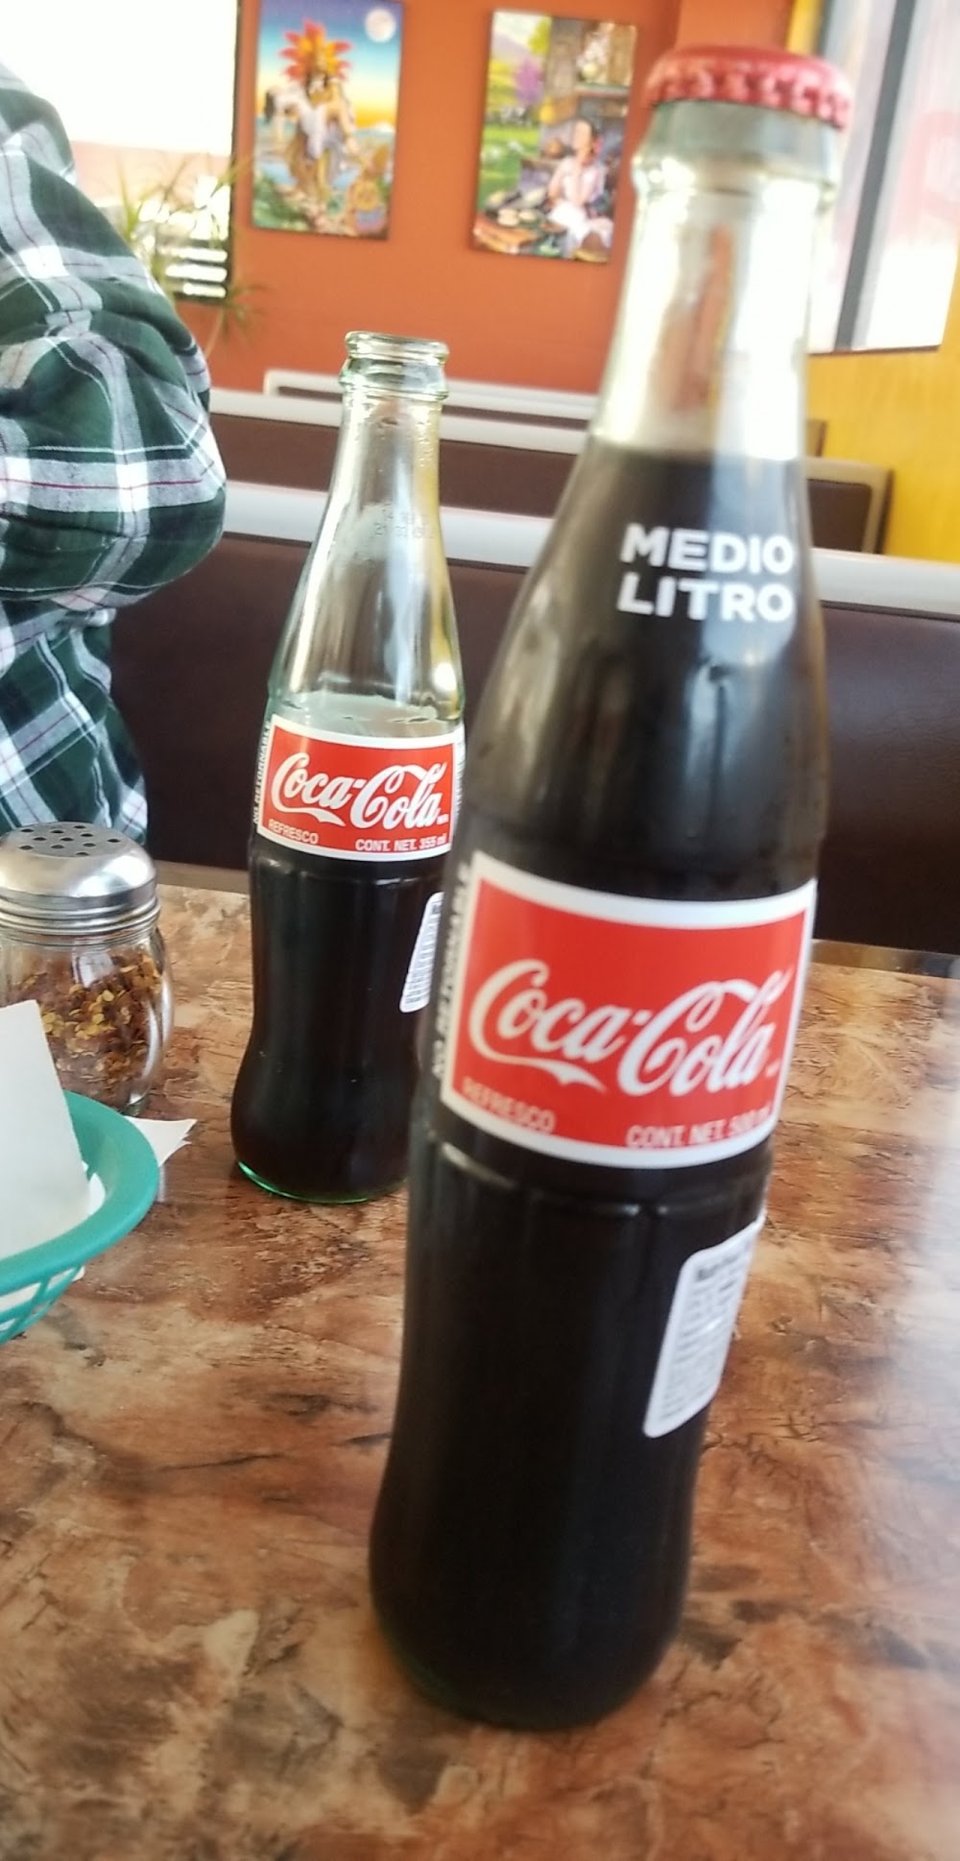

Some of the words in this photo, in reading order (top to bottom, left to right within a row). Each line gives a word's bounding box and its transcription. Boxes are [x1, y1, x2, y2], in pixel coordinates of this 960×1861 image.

[619, 522, 794, 575] MEDIO
[617, 571, 794, 622] LITRO
[271, 752, 447, 830] Coca-Cola
[268, 819, 319, 844] REFRESCO
[355, 838, 391, 851] CONT.
[393, 838, 418, 851] NET.
[419, 836, 437, 849] 355
[468, 959, 793, 1097] Coca-Cola
[462, 1076, 556, 1136] REFRESCO
